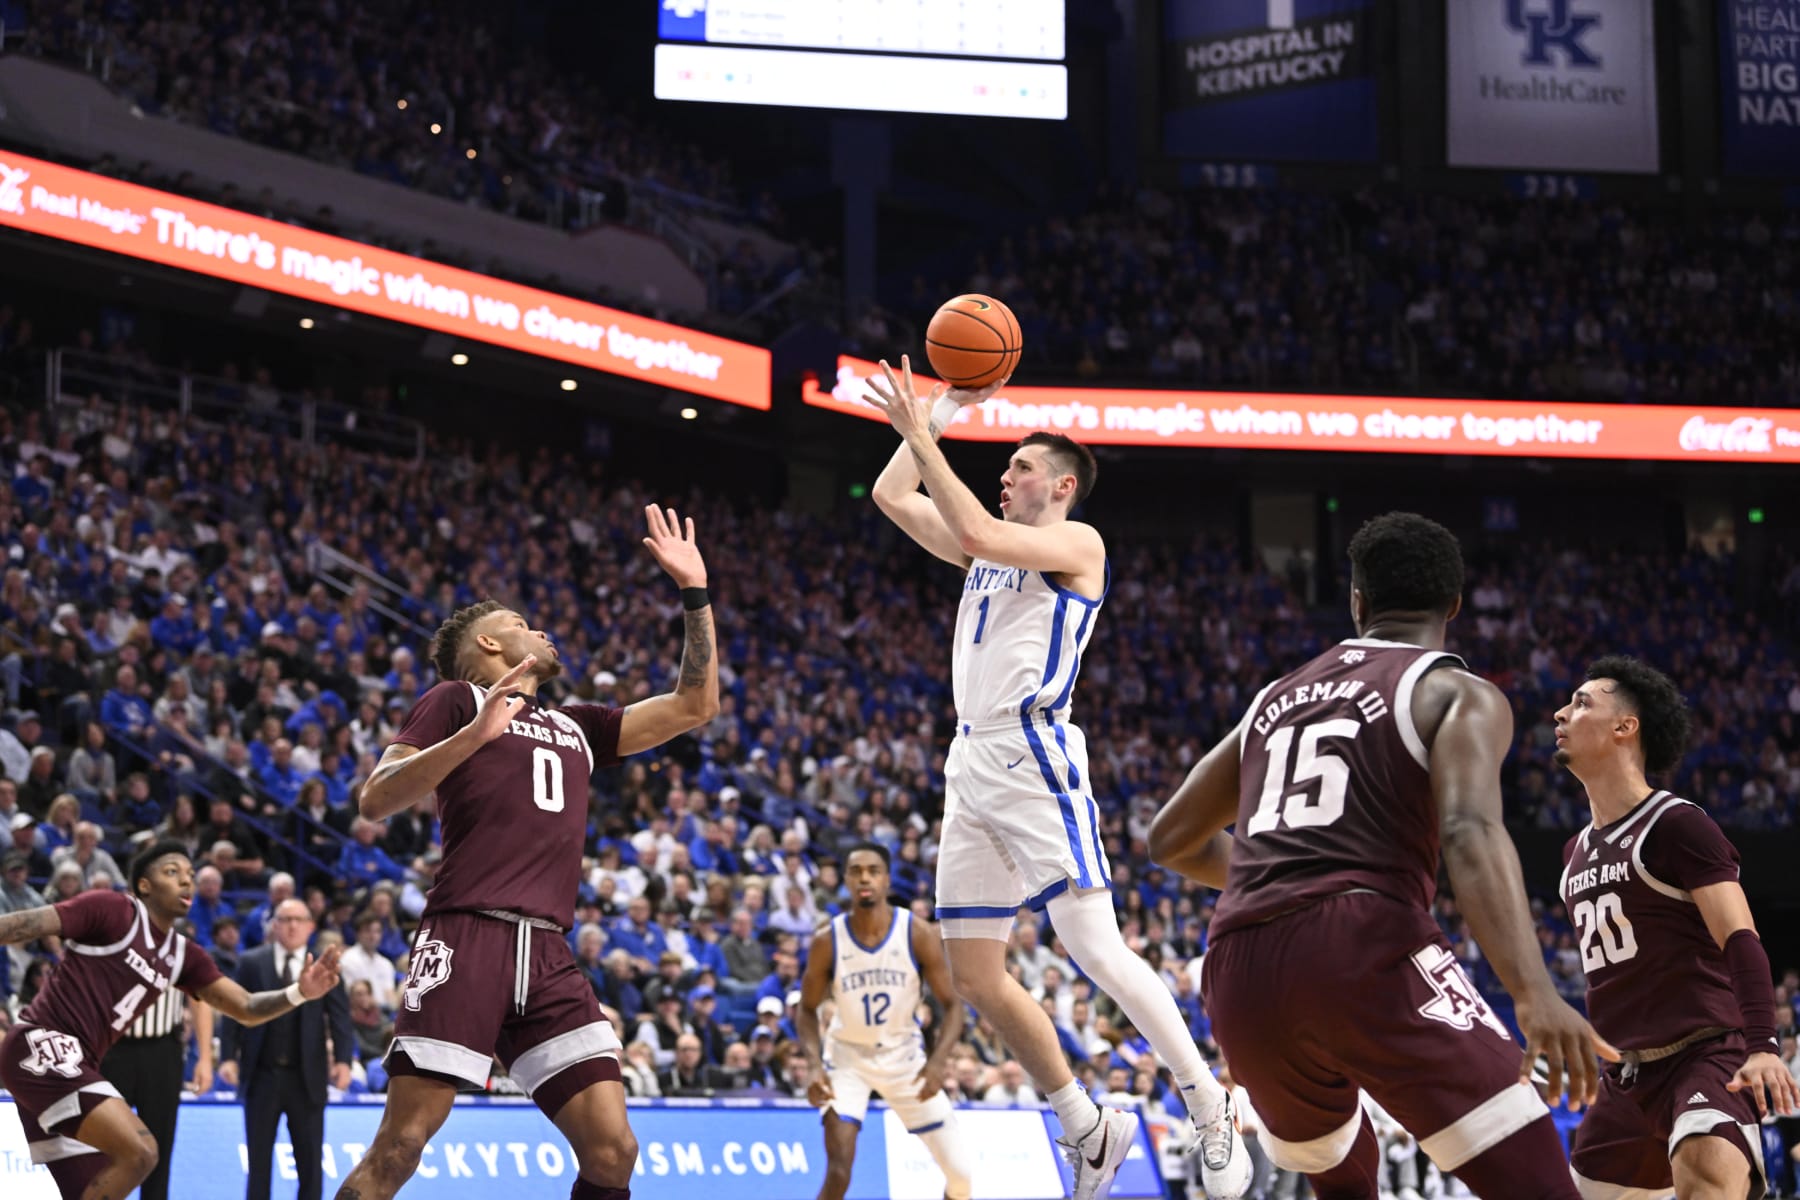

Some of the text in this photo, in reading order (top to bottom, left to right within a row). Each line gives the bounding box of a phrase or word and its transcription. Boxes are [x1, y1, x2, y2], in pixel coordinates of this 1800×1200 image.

[1186, 22, 1354, 70] HOSPITAL IN
[1735, 32, 1800, 59] PART
[1197, 50, 1344, 96] KENTUCKY
[1479, 74, 1627, 105] HealthCare
[1738, 61, 1798, 92] BIG
[31, 186, 78, 218] Real
[151, 208, 722, 380] There's magic when we cheer together
[977, 398, 1100, 429] There's
[1104, 402, 1205, 437] magic
[1210, 405, 1302, 435] when
[1307, 412, 1358, 436] we
[1364, 409, 1457, 439] cheer
[1461, 413, 1603, 446] together
[974, 595, 989, 644] 1
[1254, 680, 1389, 736] COLEMAN III
[503, 719, 582, 752] EXAS A&M
[533, 746, 565, 813] 0
[1248, 718, 1361, 838] 15
[1568, 861, 1631, 896] TEXAS A&M
[1573, 892, 1639, 974] 20
[842, 968, 907, 992] KENTUCKY
[111, 984, 148, 1031] 4
[862, 992, 891, 1026] 12
